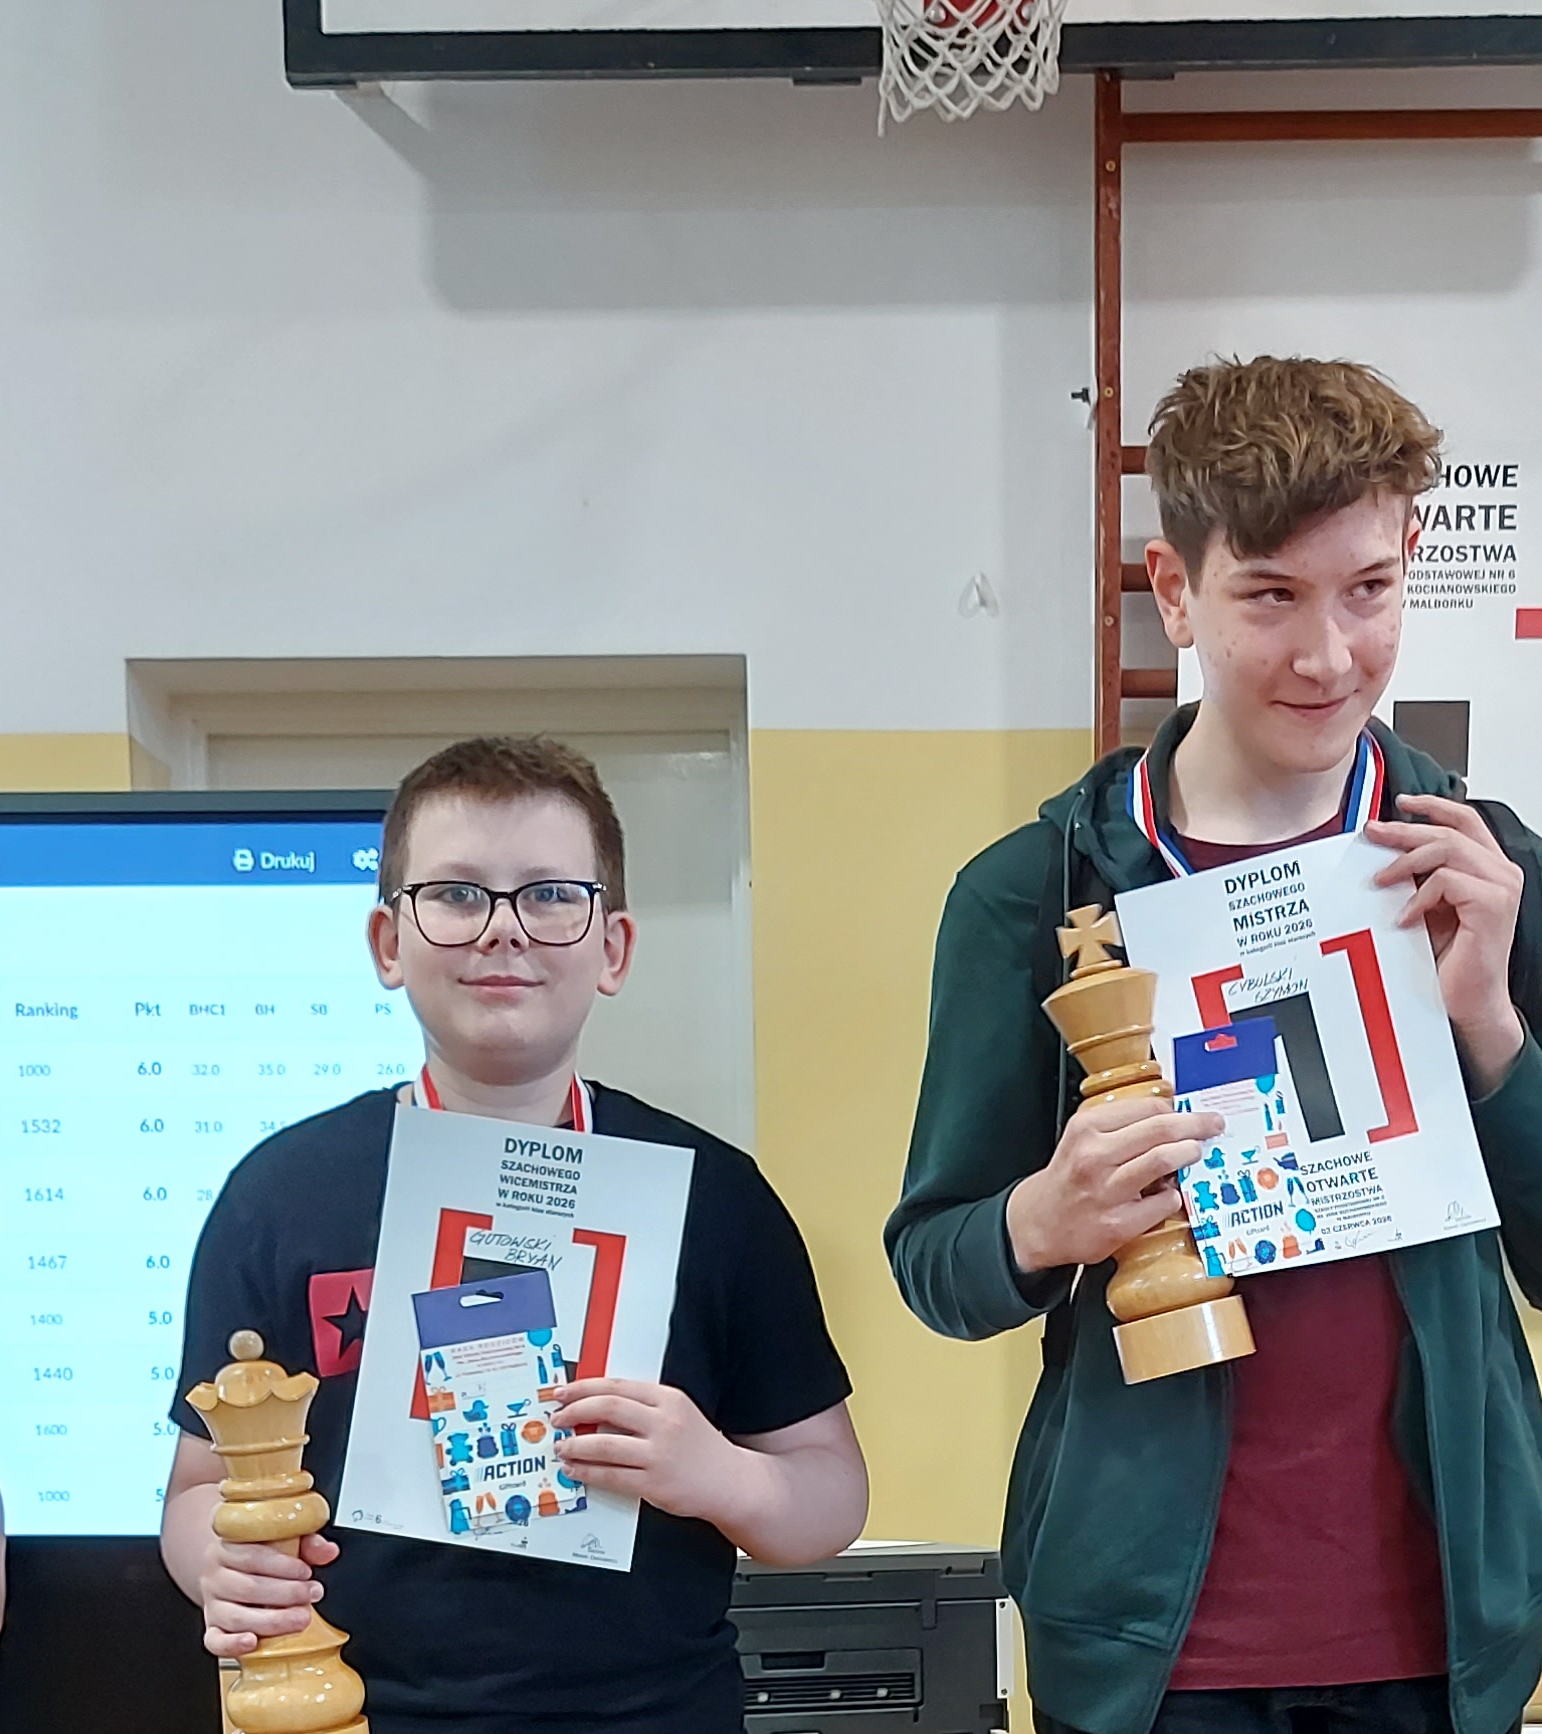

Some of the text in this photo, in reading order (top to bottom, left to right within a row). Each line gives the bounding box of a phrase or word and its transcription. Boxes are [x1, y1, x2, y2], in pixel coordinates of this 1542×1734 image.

[1406, 569, 1486, 581] ODSTAWOWEJ
[259, 851, 316, 873] Drukuj
[1224, 860, 1301, 894] DYPLOM
[1228, 882, 1305, 911] SZACHOWEGO
[1233, 899, 1310, 931] MISTRZA
[1236, 937, 1247, 948] W
[1250, 926, 1282, 944] ROKU
[15, 1002, 79, 1020] Ranking
[135, 1002, 161, 1017] Pkt
[18, 1064, 51, 1077] 1000
[137, 1062, 162, 1075] 6.0
[21, 1119, 61, 1134] 1532
[140, 1118, 164, 1133] 6.0
[504, 1137, 584, 1164] DYPLOM
[500, 1160, 580, 1180] SZACHOWEGO
[1300, 1150, 1373, 1176] SZACHOWE
[499, 1174, 577, 1195] WICEMISTRZA
[1306, 1167, 1378, 1193] OTWARTE
[25, 1187, 64, 1202] 1614
[143, 1186, 167, 1201] 6.0
[498, 1187, 576, 1210] W ROKU 2026
[1231, 1201, 1285, 1227] ACTION
[28, 1255, 170, 1270] 1467 6.0
[30, 1311, 172, 1326] 1400 5.0
[33, 1366, 174, 1381] 1440 5.0
[36, 1422, 176, 1436] 1600 5.0
[483, 1455, 546, 1481] ACTION
